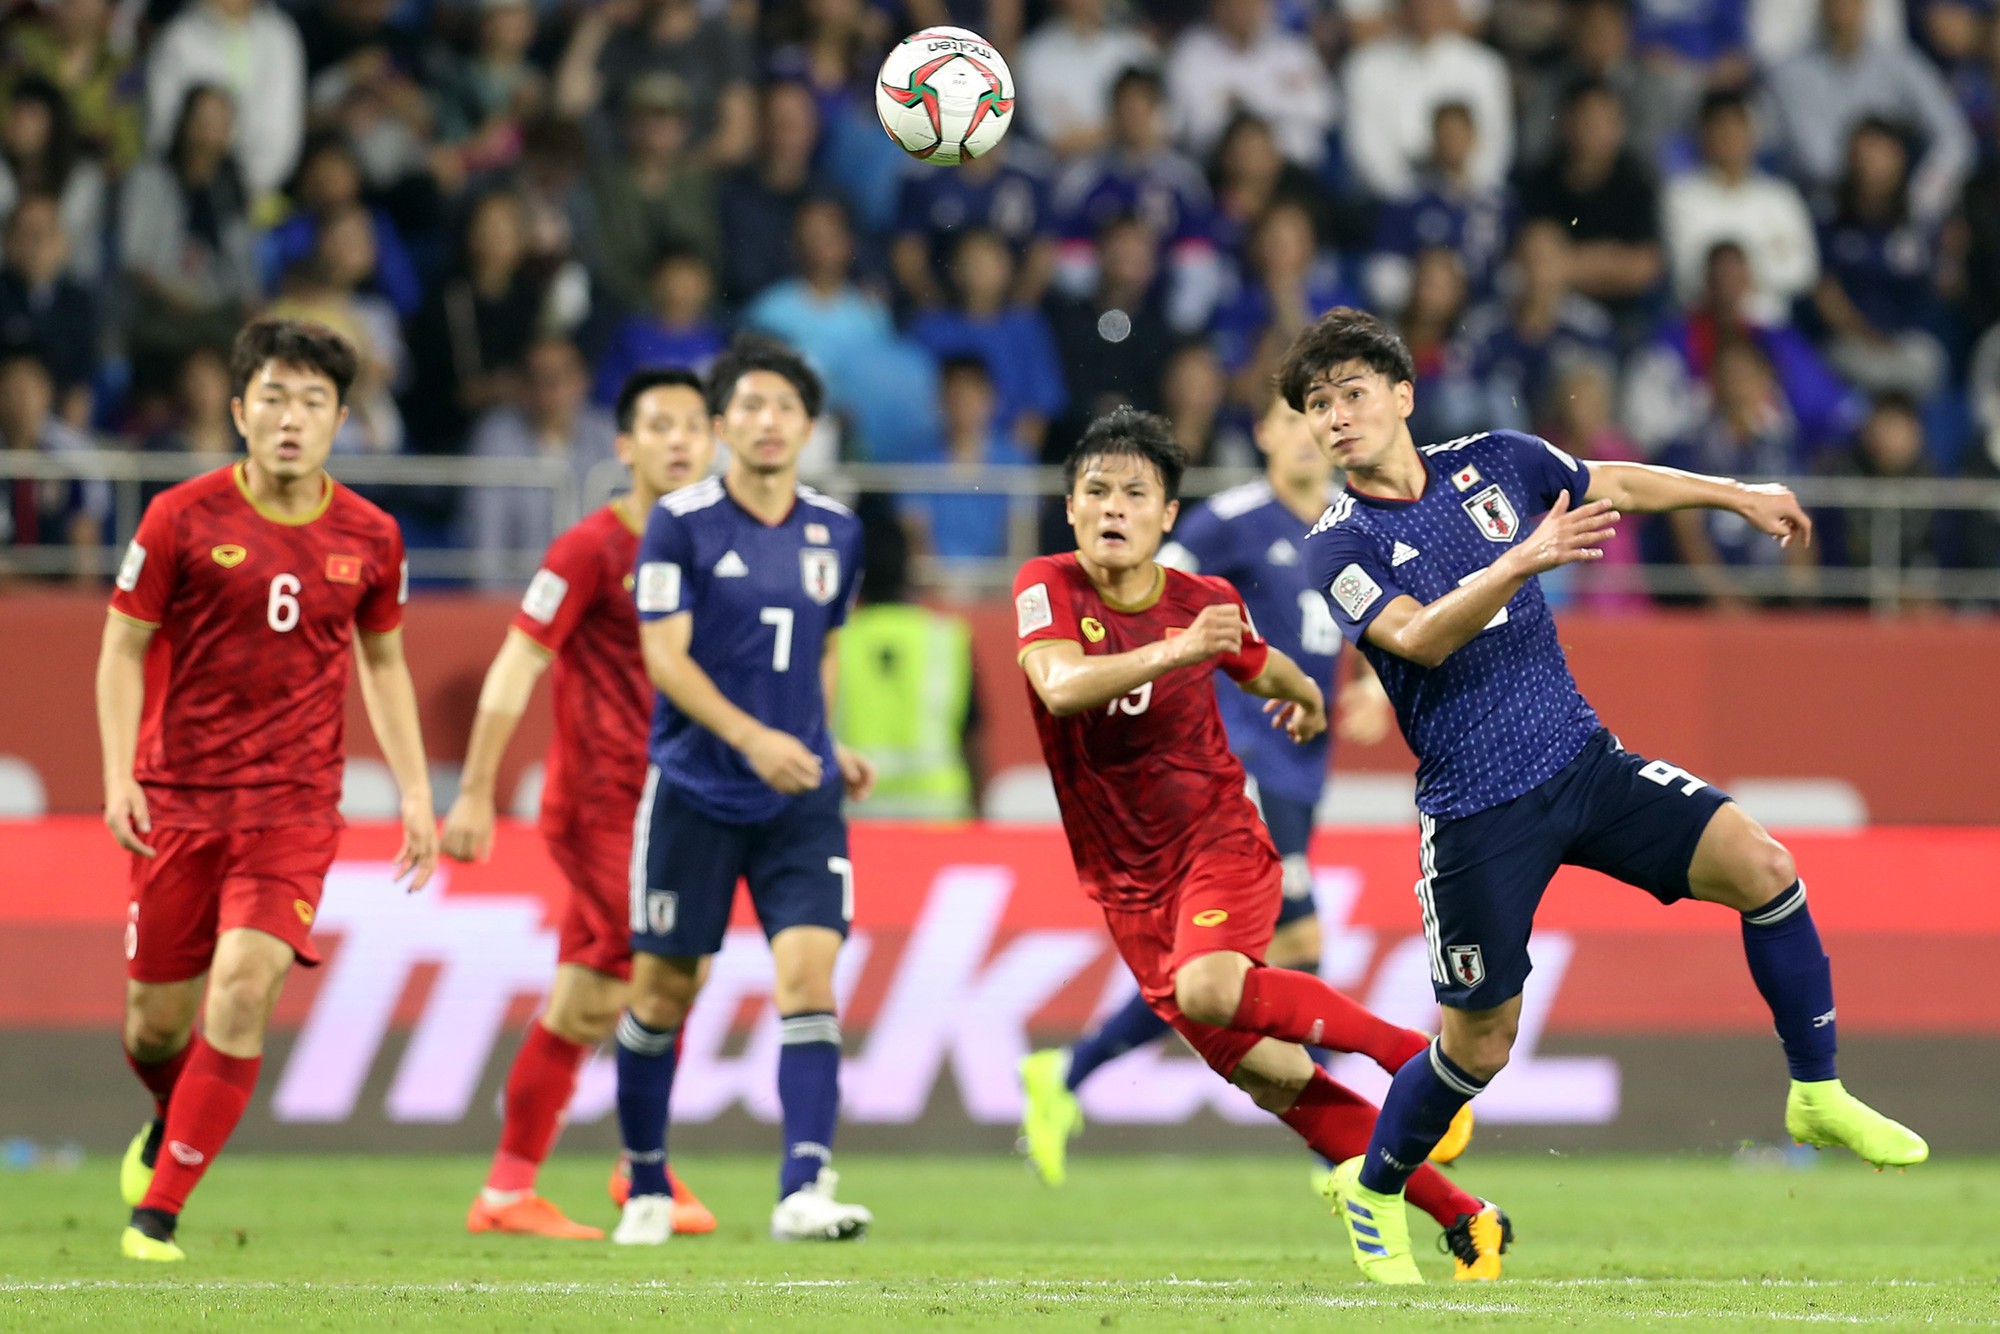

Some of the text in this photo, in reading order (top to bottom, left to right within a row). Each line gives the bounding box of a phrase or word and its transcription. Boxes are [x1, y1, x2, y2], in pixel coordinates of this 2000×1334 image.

[927, 41, 991, 59] molten
[267, 573, 302, 633] 6
[760, 607, 794, 672] 7
[1637, 759, 1708, 797] 9
[827, 856, 854, 922] 7
